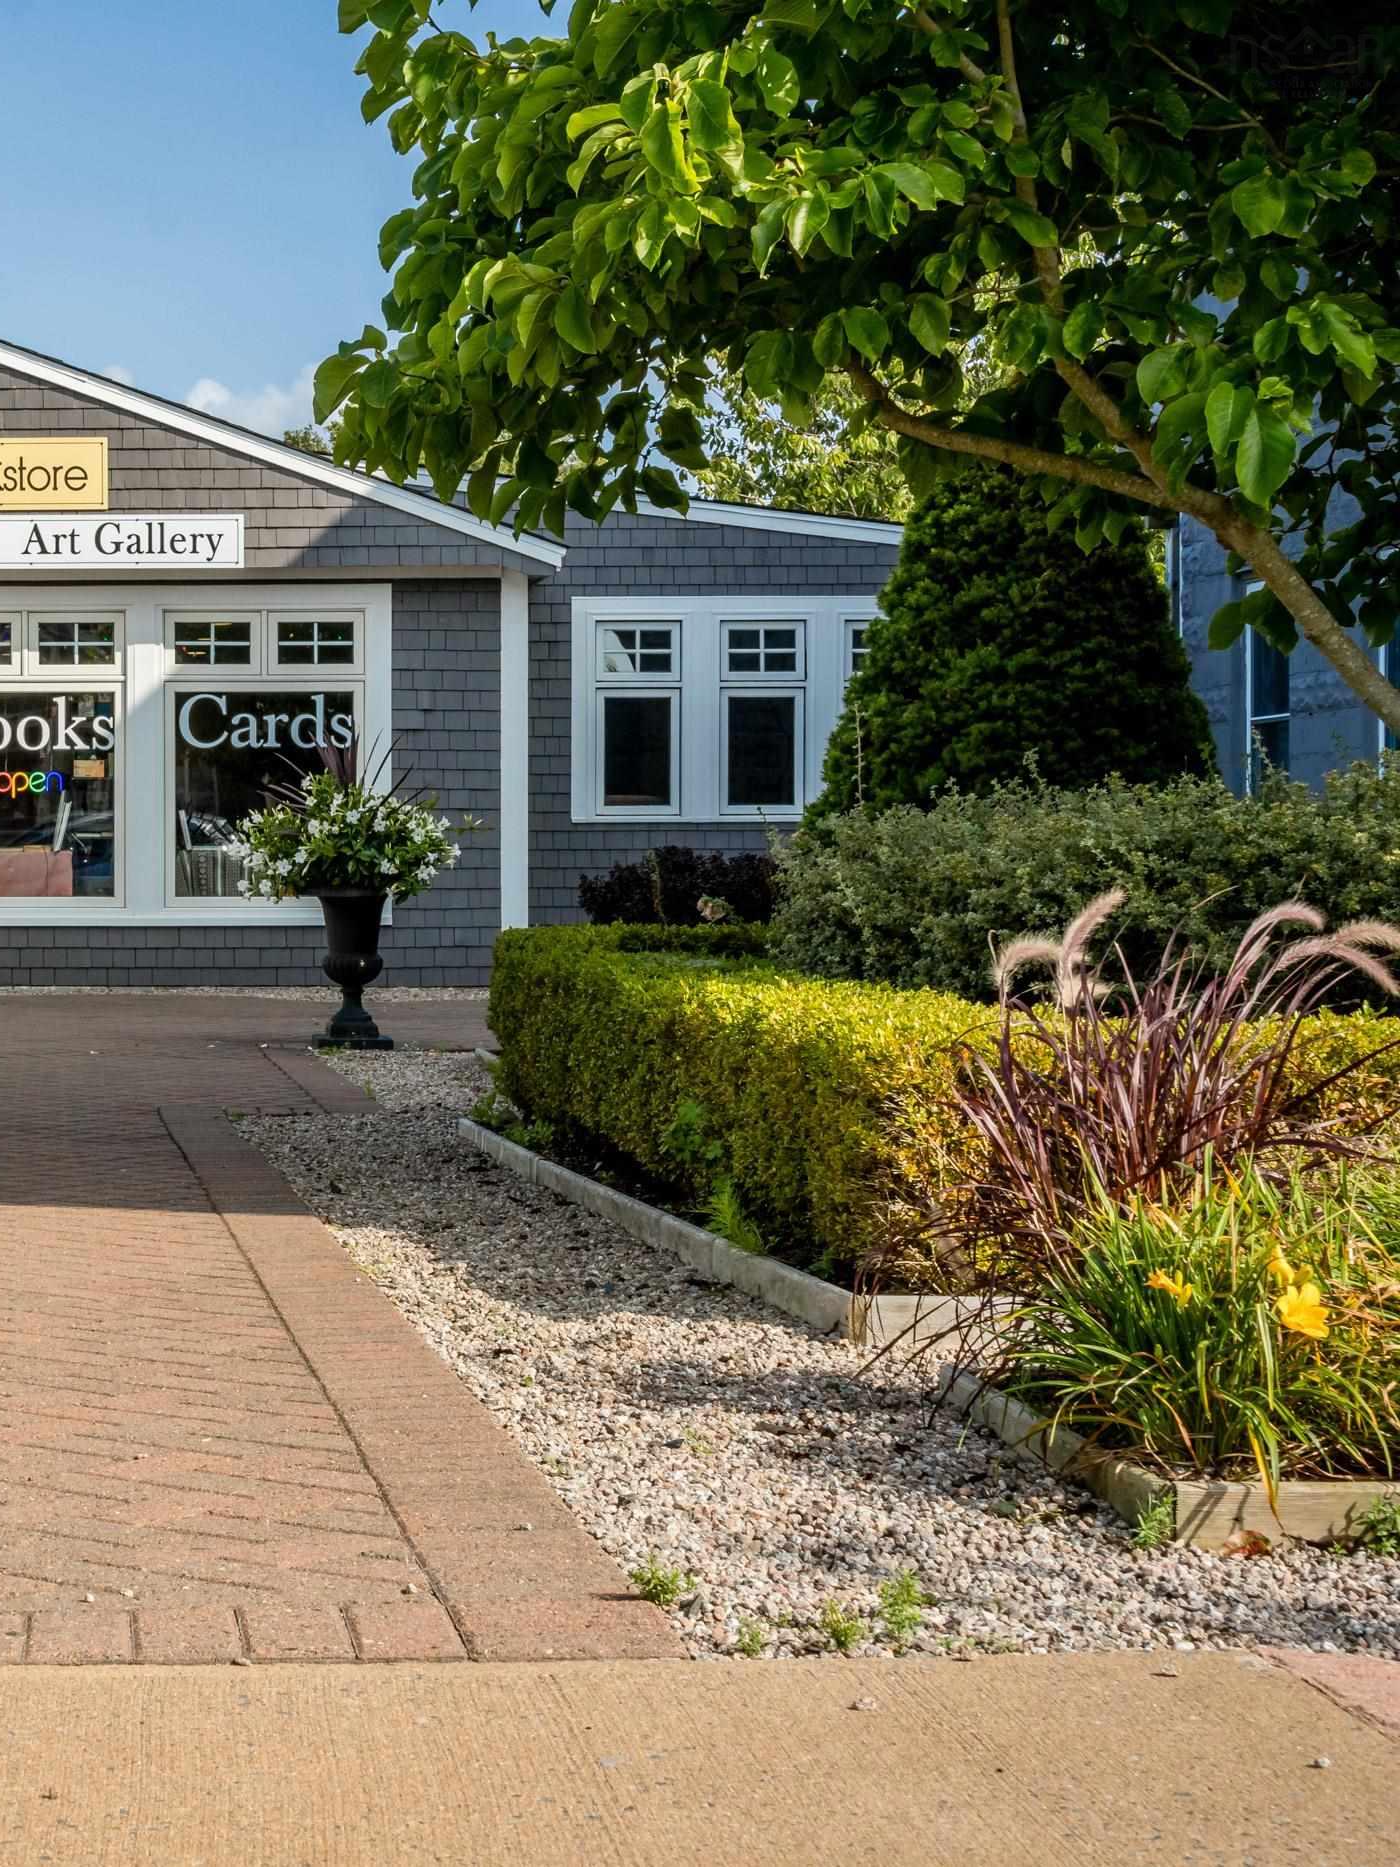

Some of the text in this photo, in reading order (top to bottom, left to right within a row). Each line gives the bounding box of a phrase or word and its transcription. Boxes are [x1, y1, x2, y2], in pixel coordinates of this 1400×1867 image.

[21, 522, 82, 556] Art
[94, 521, 225, 562] Gallery
[178, 693, 353, 749] Cards
